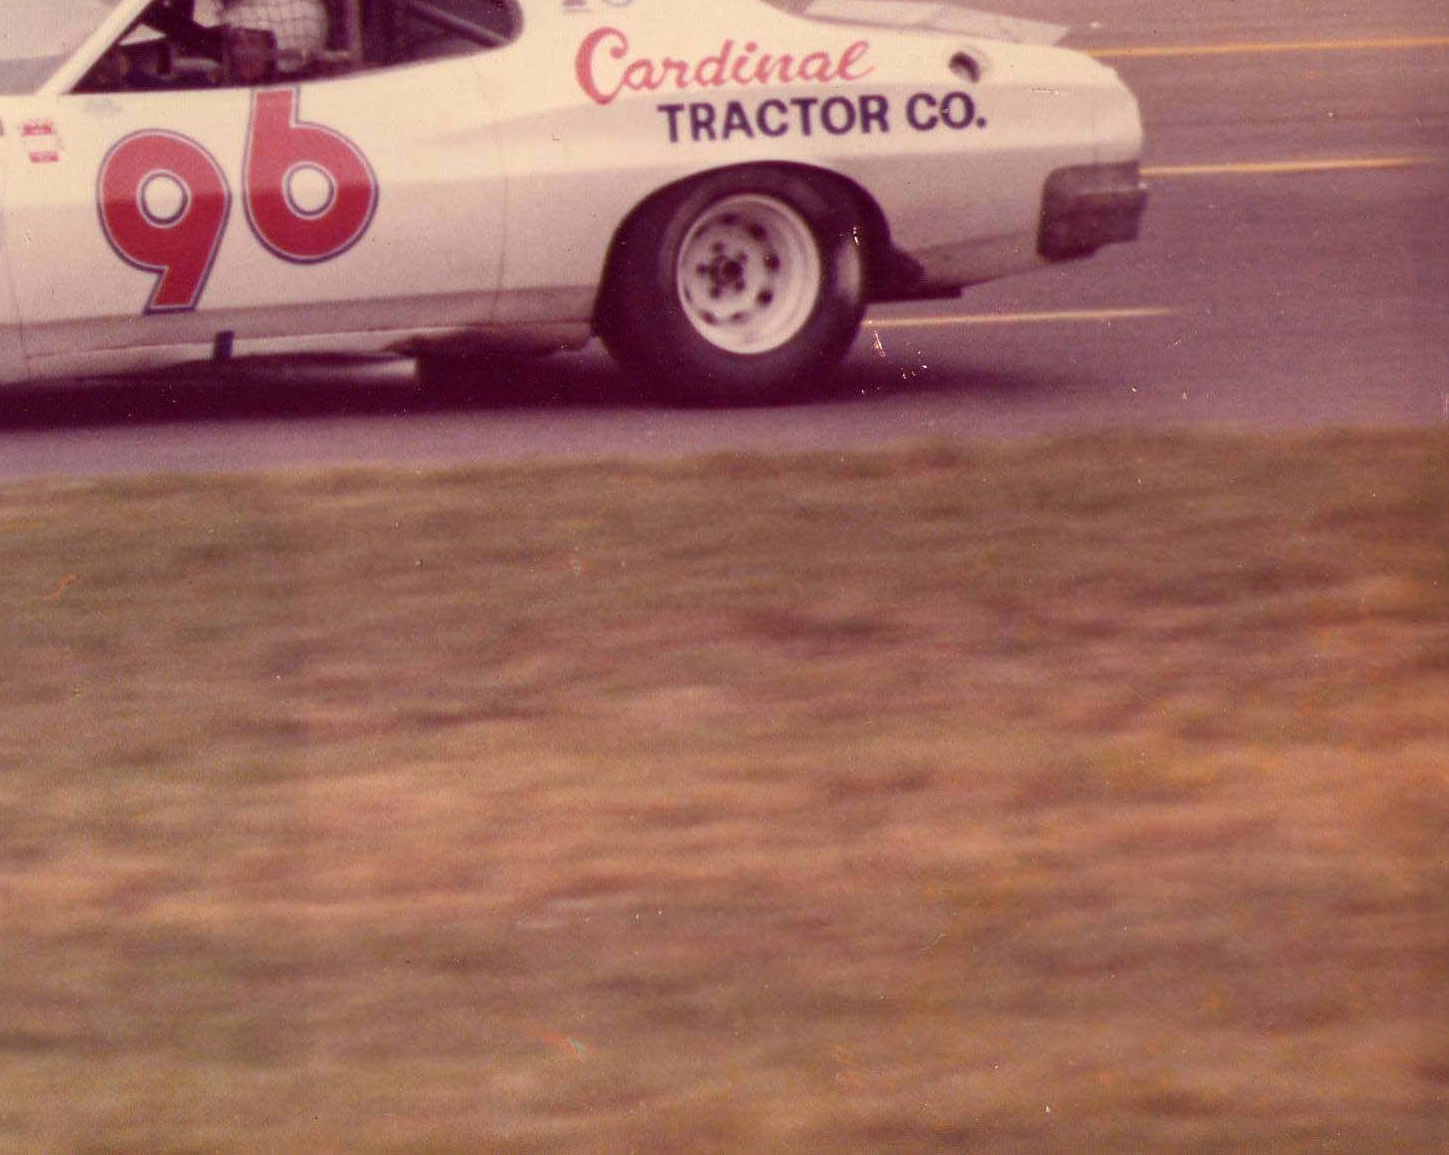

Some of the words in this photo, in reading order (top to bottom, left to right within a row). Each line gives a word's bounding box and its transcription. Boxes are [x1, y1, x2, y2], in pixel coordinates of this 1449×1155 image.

[575, 26, 874, 106] Cardinal
[656, 94, 890, 143] TRACTOR
[906, 91, 987, 132] CO.
[96, 85, 379, 316] 96
